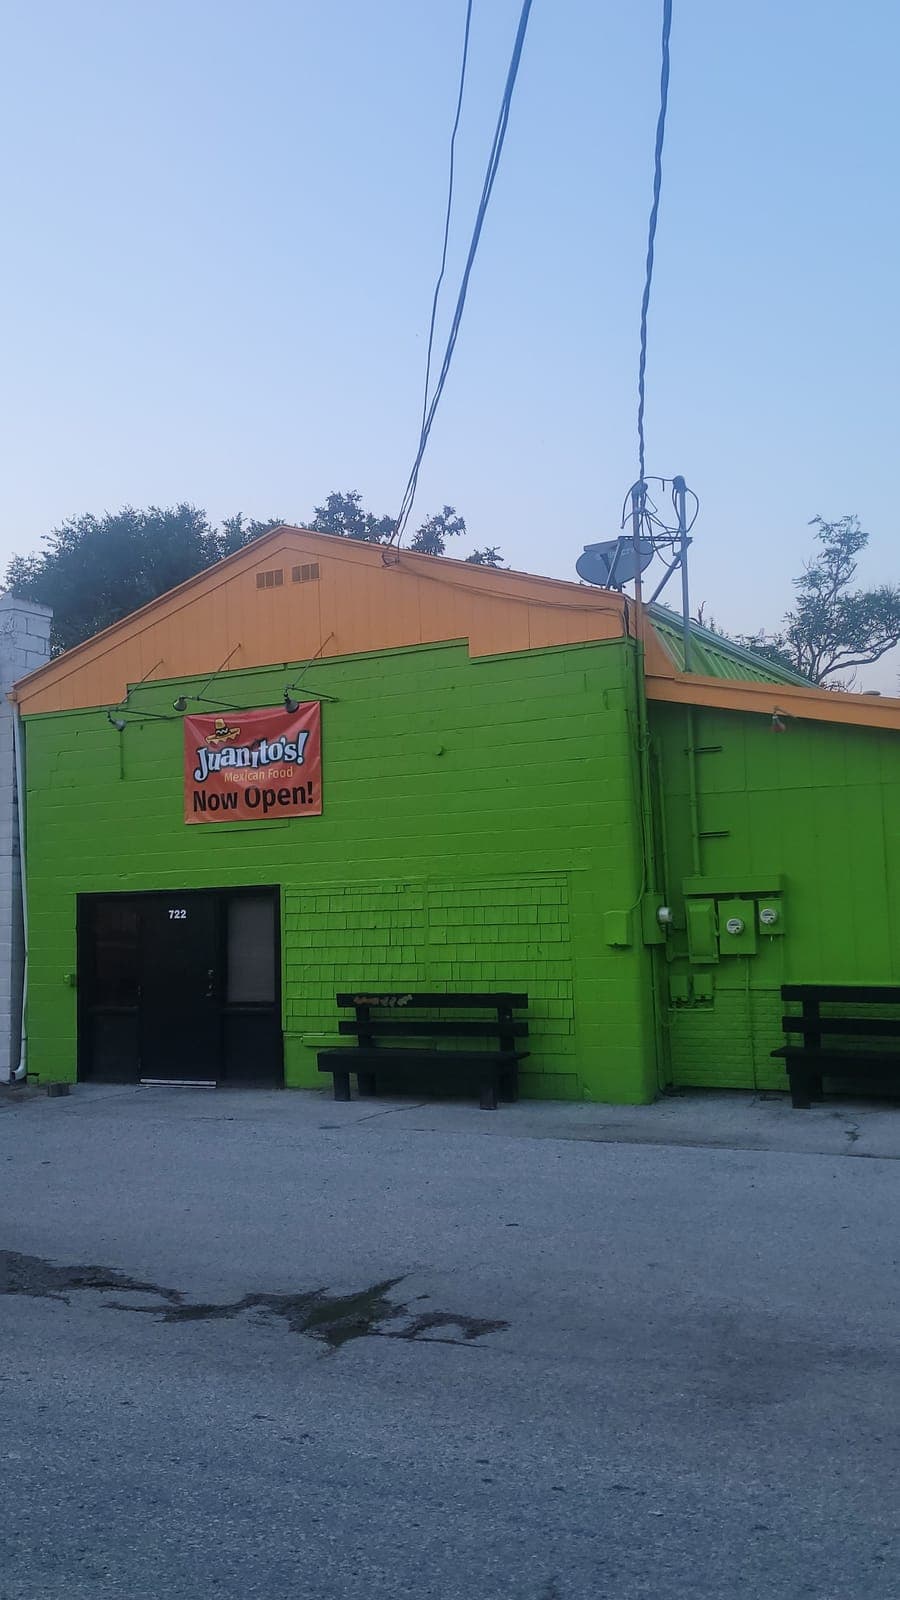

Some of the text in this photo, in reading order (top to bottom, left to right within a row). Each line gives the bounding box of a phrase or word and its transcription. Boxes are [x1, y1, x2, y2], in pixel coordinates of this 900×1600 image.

[194, 730, 309, 782] Juanito's!
[224, 767, 293, 783] Mexican Food
[193, 781, 314, 813] Now Open!
[168, 909, 187, 919] 722
